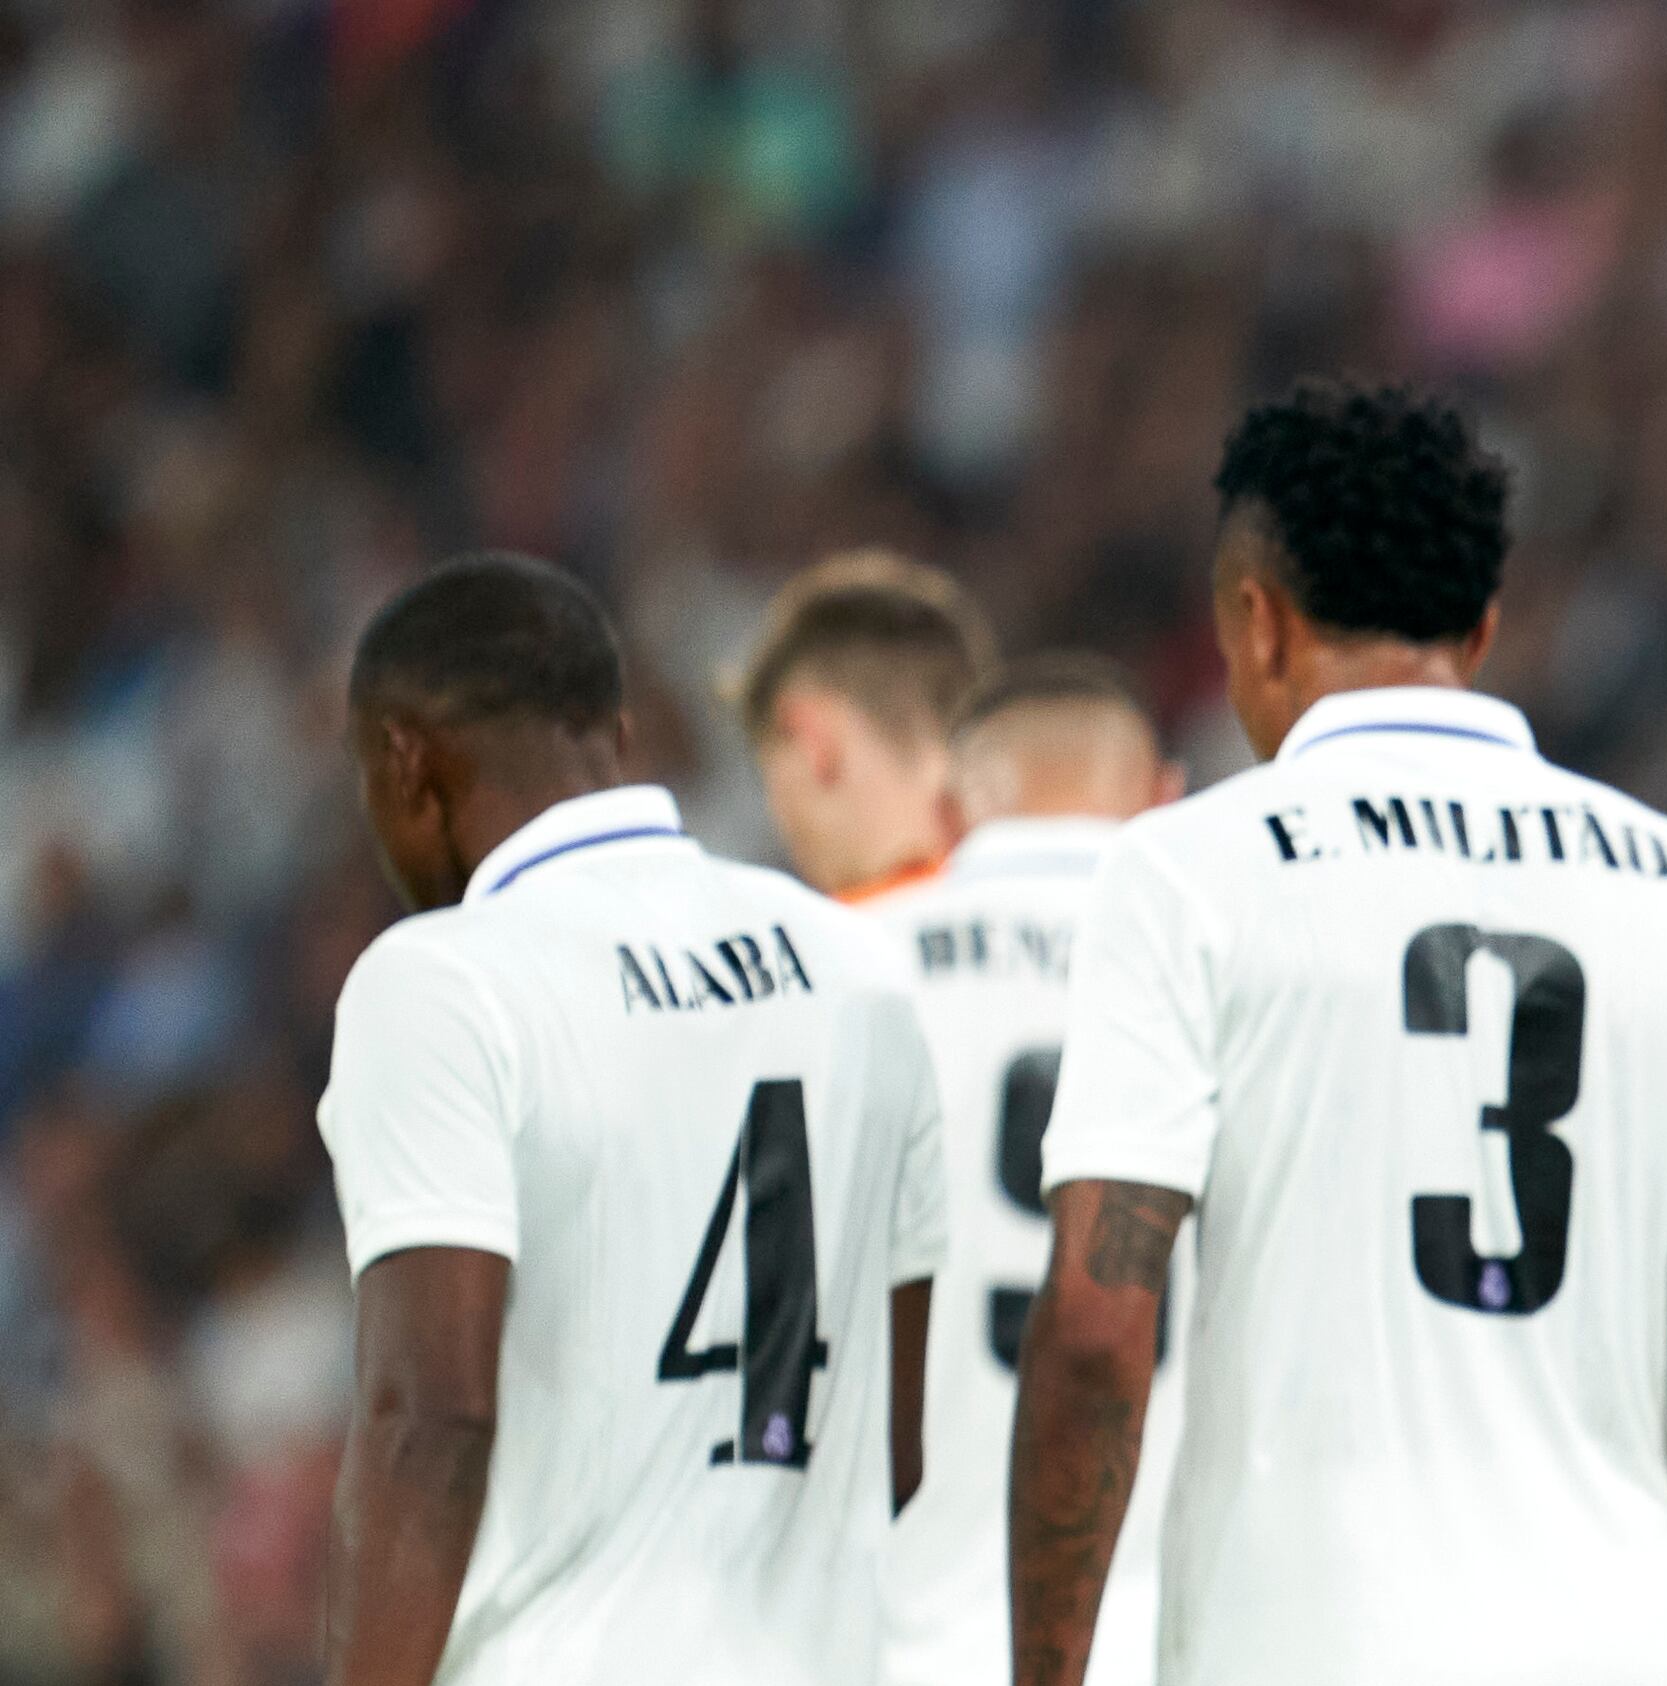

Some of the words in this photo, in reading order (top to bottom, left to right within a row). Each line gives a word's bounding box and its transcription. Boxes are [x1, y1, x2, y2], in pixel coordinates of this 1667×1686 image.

[616, 920, 813, 1015] ALABA
[1402, 922, 1585, 1315] 3
[656, 1076, 829, 1470] 4
